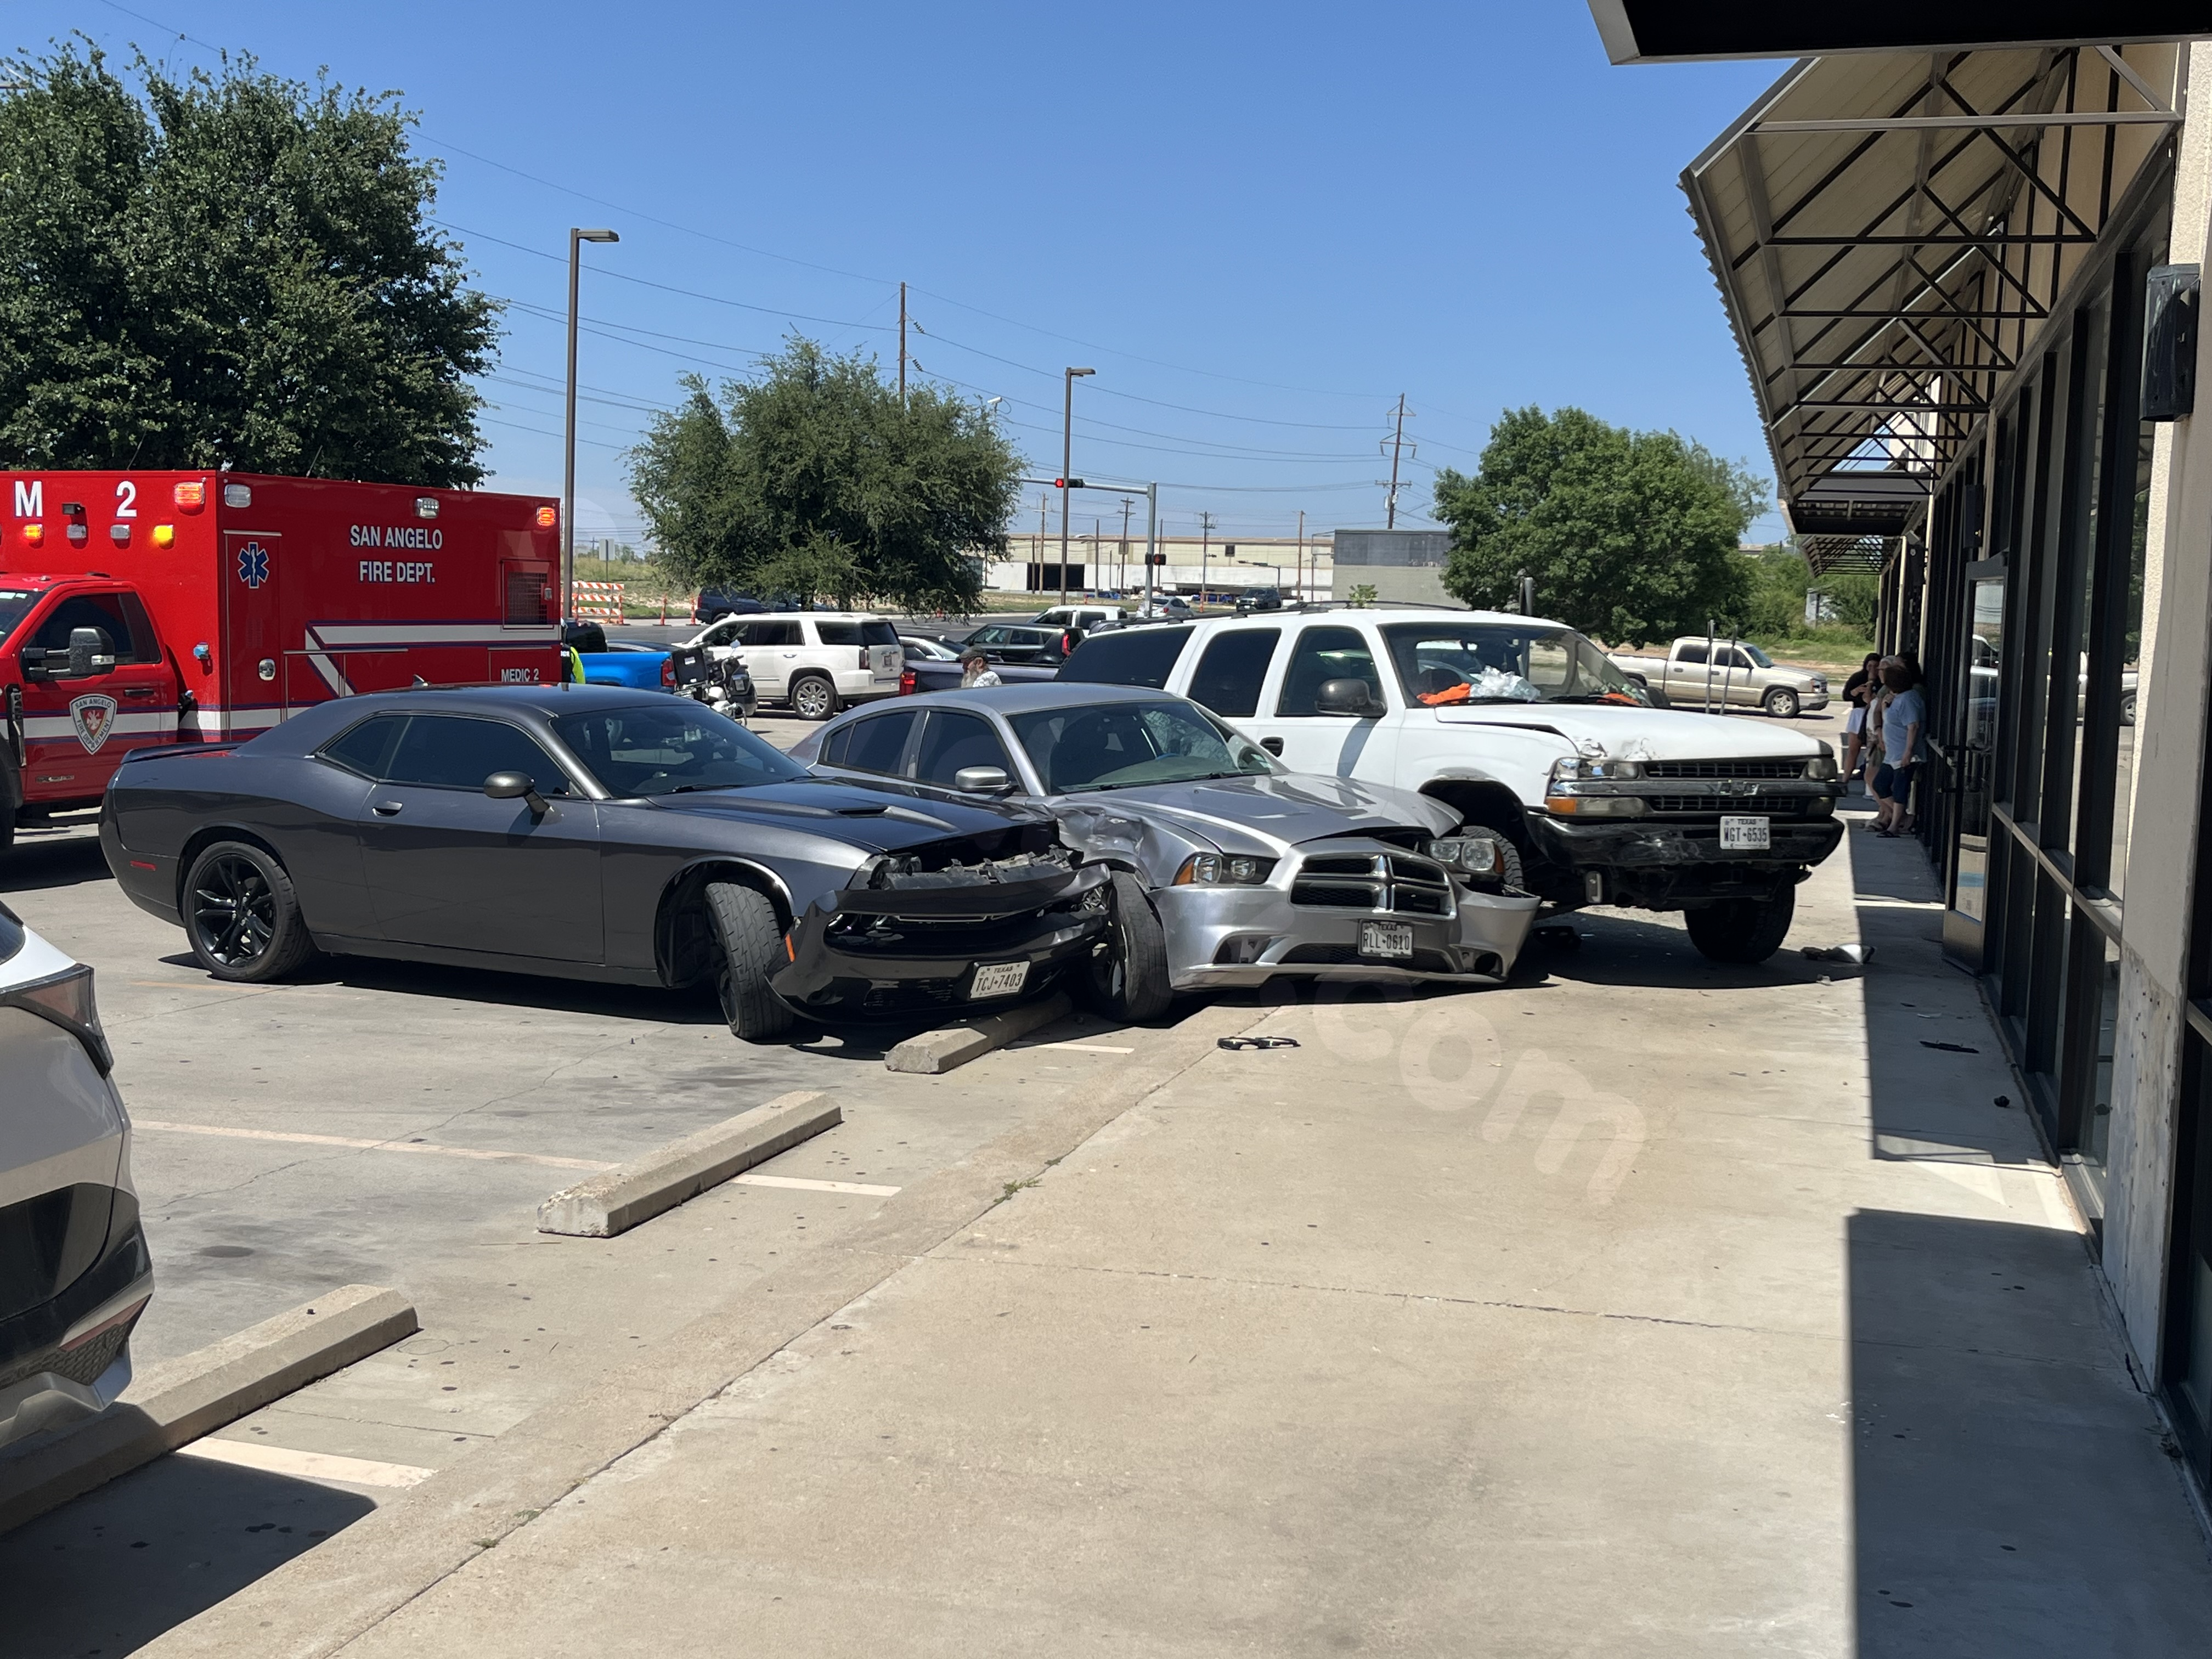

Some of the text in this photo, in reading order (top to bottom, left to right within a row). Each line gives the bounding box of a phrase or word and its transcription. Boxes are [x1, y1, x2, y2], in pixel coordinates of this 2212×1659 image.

[15, 480, 137, 517] M 2
[350, 524, 443, 550] SAN ANGELO
[359, 561, 436, 583] FIRE DEPT.
[501, 668, 539, 682] MEDIC 2
[75, 698, 112, 709] SAN ANGELO
[77, 719, 86, 735] FIRE
[994, 966, 1014, 974] TEXAS
